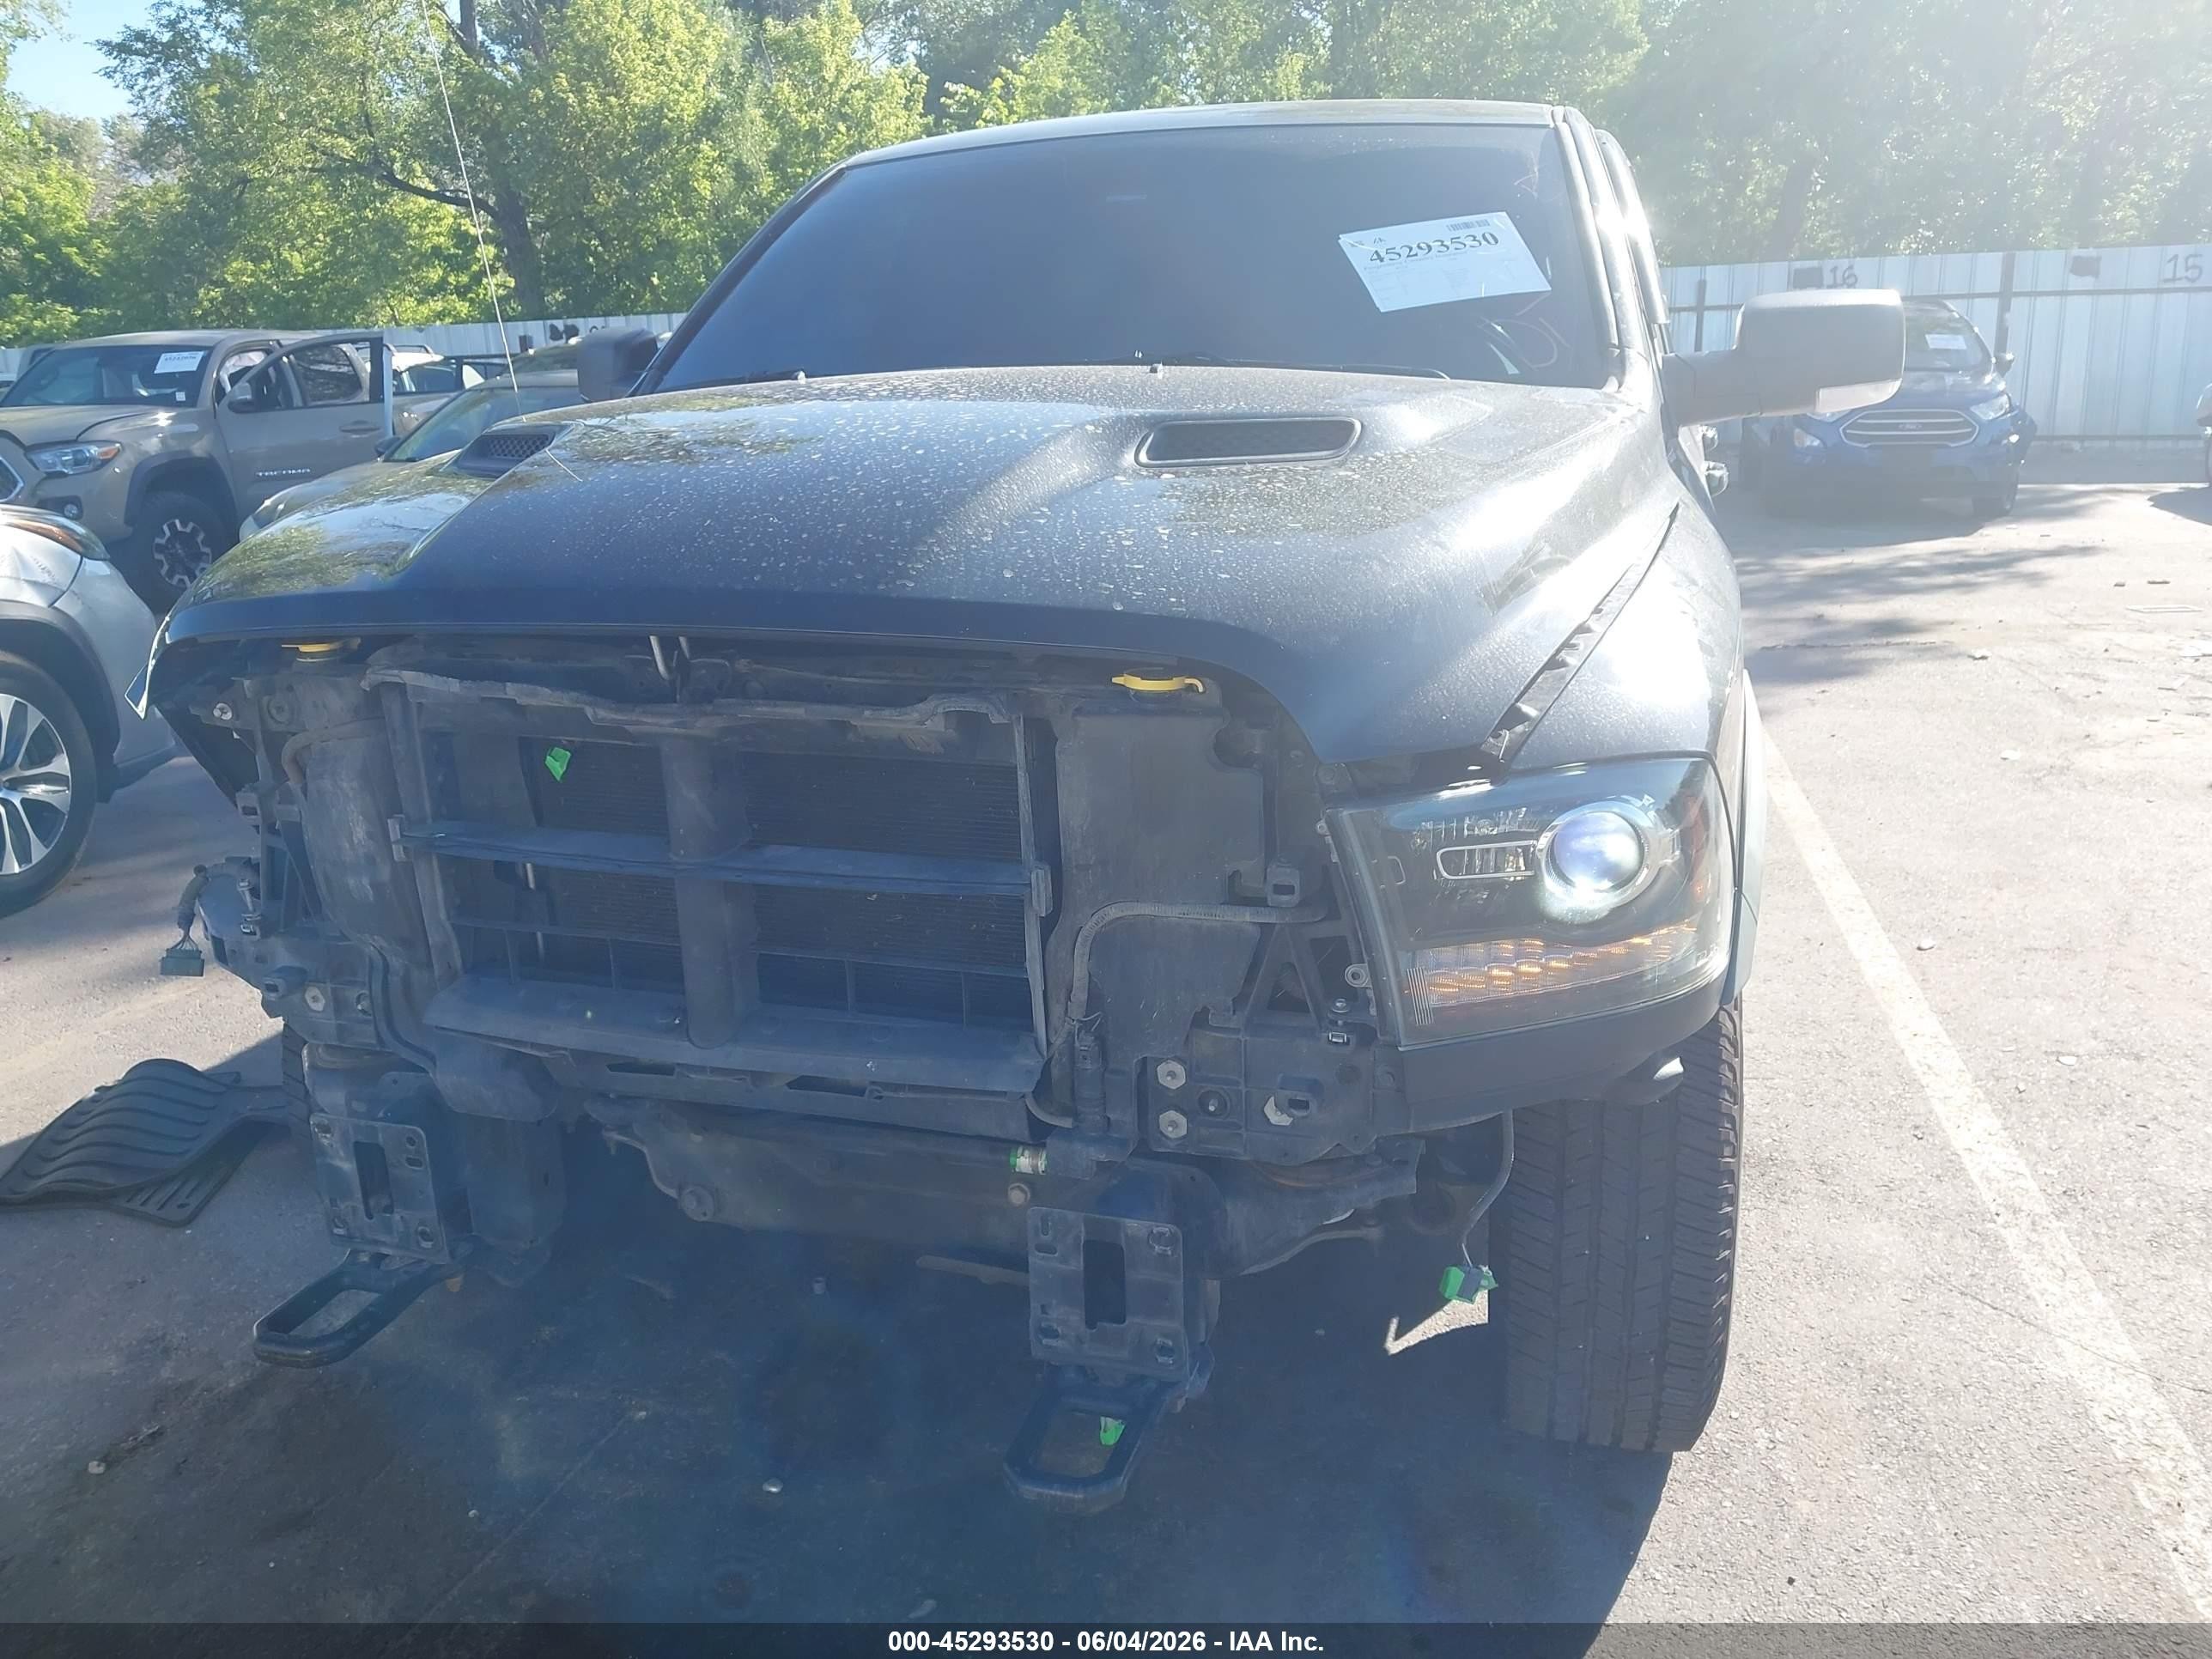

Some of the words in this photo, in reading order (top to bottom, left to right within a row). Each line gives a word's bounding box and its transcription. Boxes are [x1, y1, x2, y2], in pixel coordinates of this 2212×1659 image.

[1370, 232, 1499, 263] 45293530
[1826, 264, 1858, 289] 16
[2163, 254, 2203, 283] 15
[256, 468, 311, 477] TACOMA
